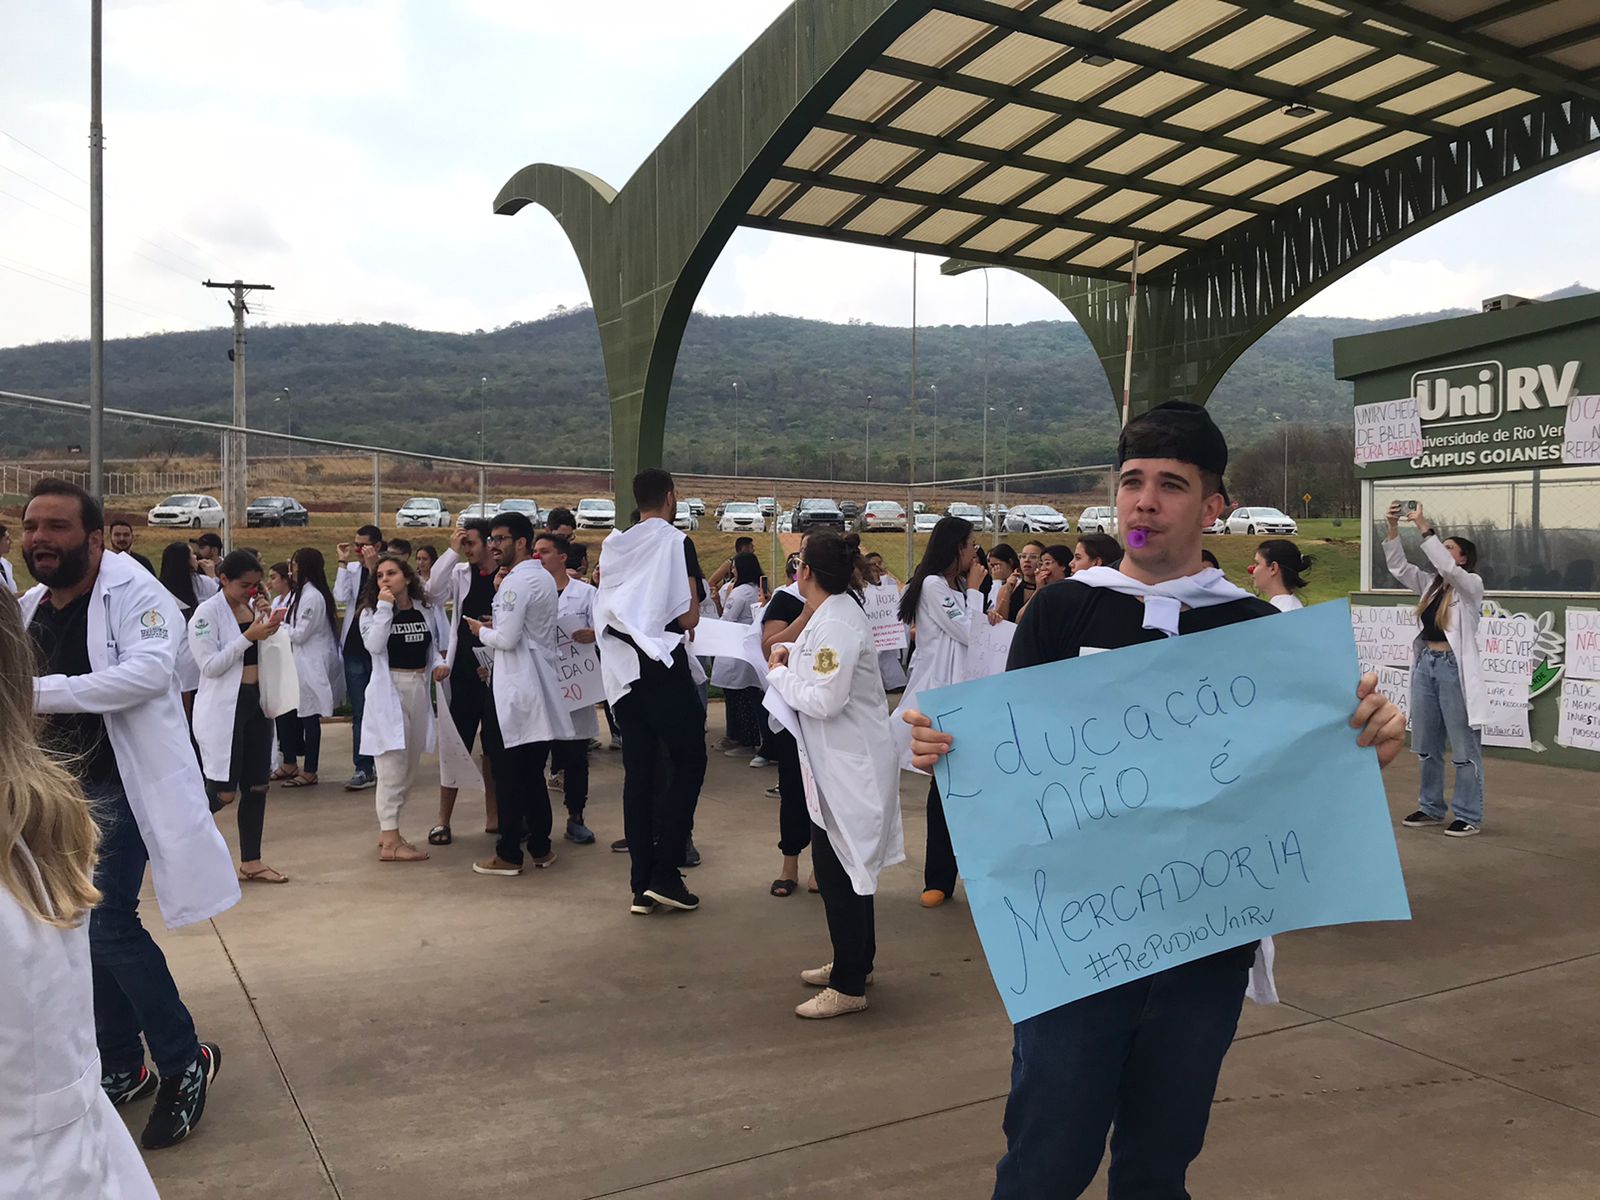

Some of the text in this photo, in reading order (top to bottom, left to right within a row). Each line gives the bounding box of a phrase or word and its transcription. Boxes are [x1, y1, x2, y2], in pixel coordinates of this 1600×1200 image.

[1357, 423, 1419, 447] DE BALELA
[1422, 424, 1564, 448] niversidade de Rio Ver
[1410, 451, 1475, 470] CÂMPUS
[1566, 441, 1600, 459] REPR
[1380, 627, 1395, 640] OS
[1487, 621, 1526, 638] NOSSO
[936, 675, 1257, 800] Educação
[1035, 739, 1241, 841] não é
